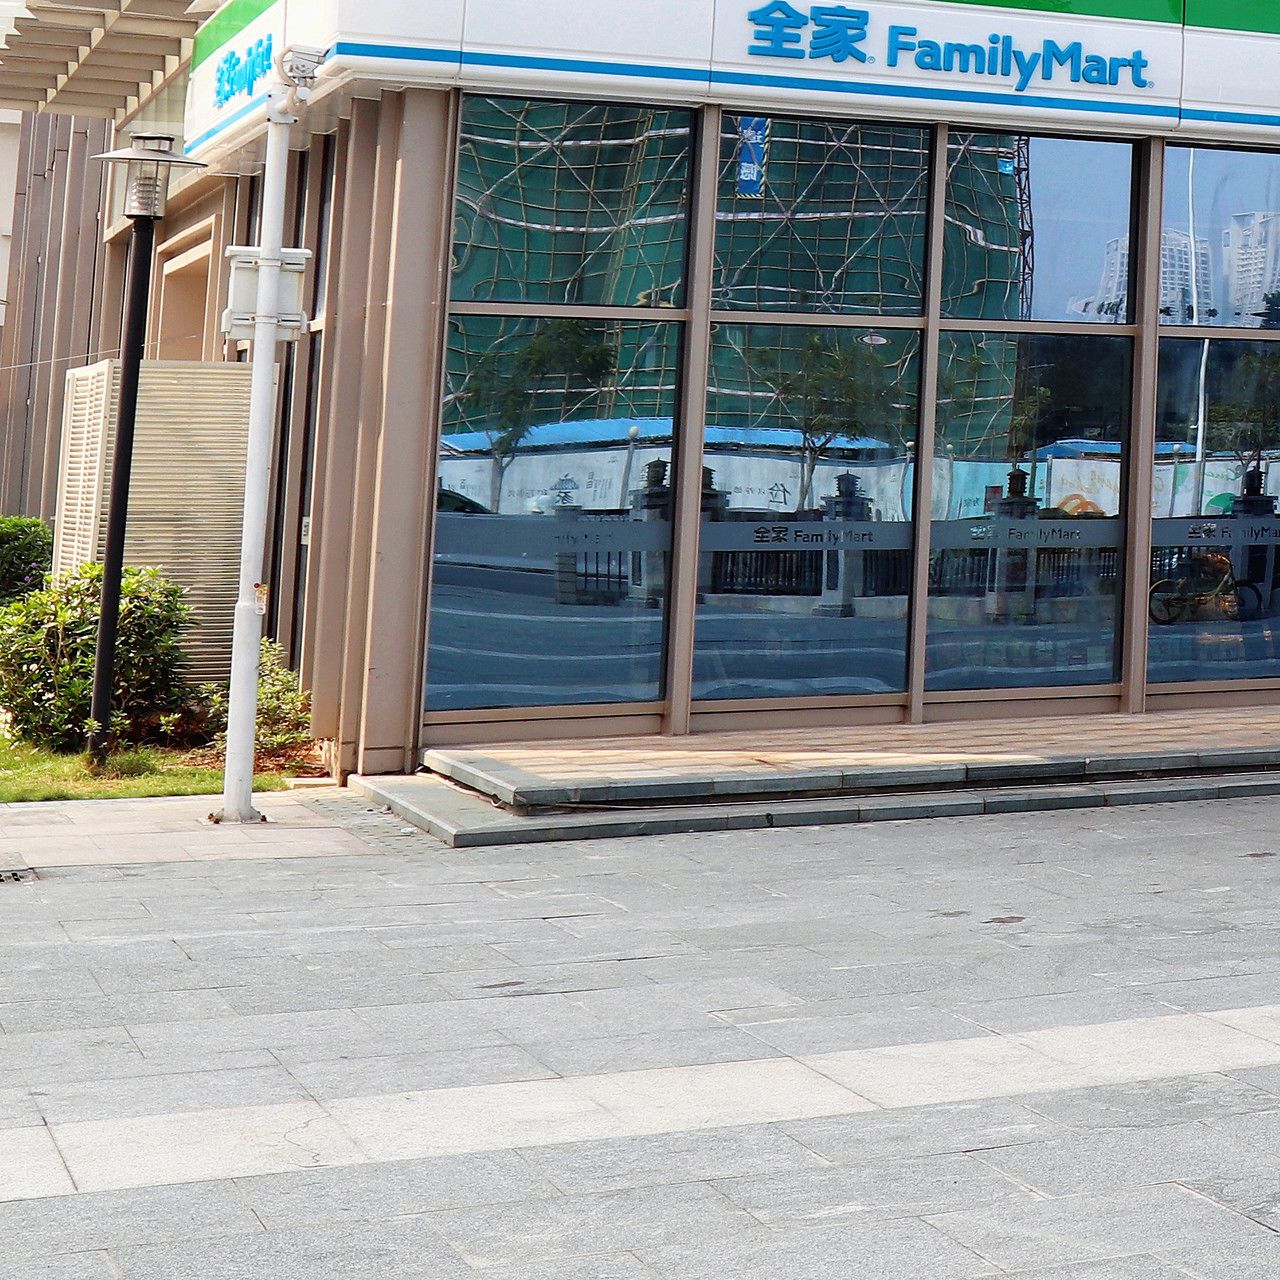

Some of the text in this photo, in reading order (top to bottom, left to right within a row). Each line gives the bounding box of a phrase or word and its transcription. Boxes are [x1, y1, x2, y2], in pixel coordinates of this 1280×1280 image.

[747, 0, 1149, 92] 全家 FamilyMart
[753, 526, 873, 545] 全家 FamlyMart
[1008, 528, 1081, 543] FalyMart
